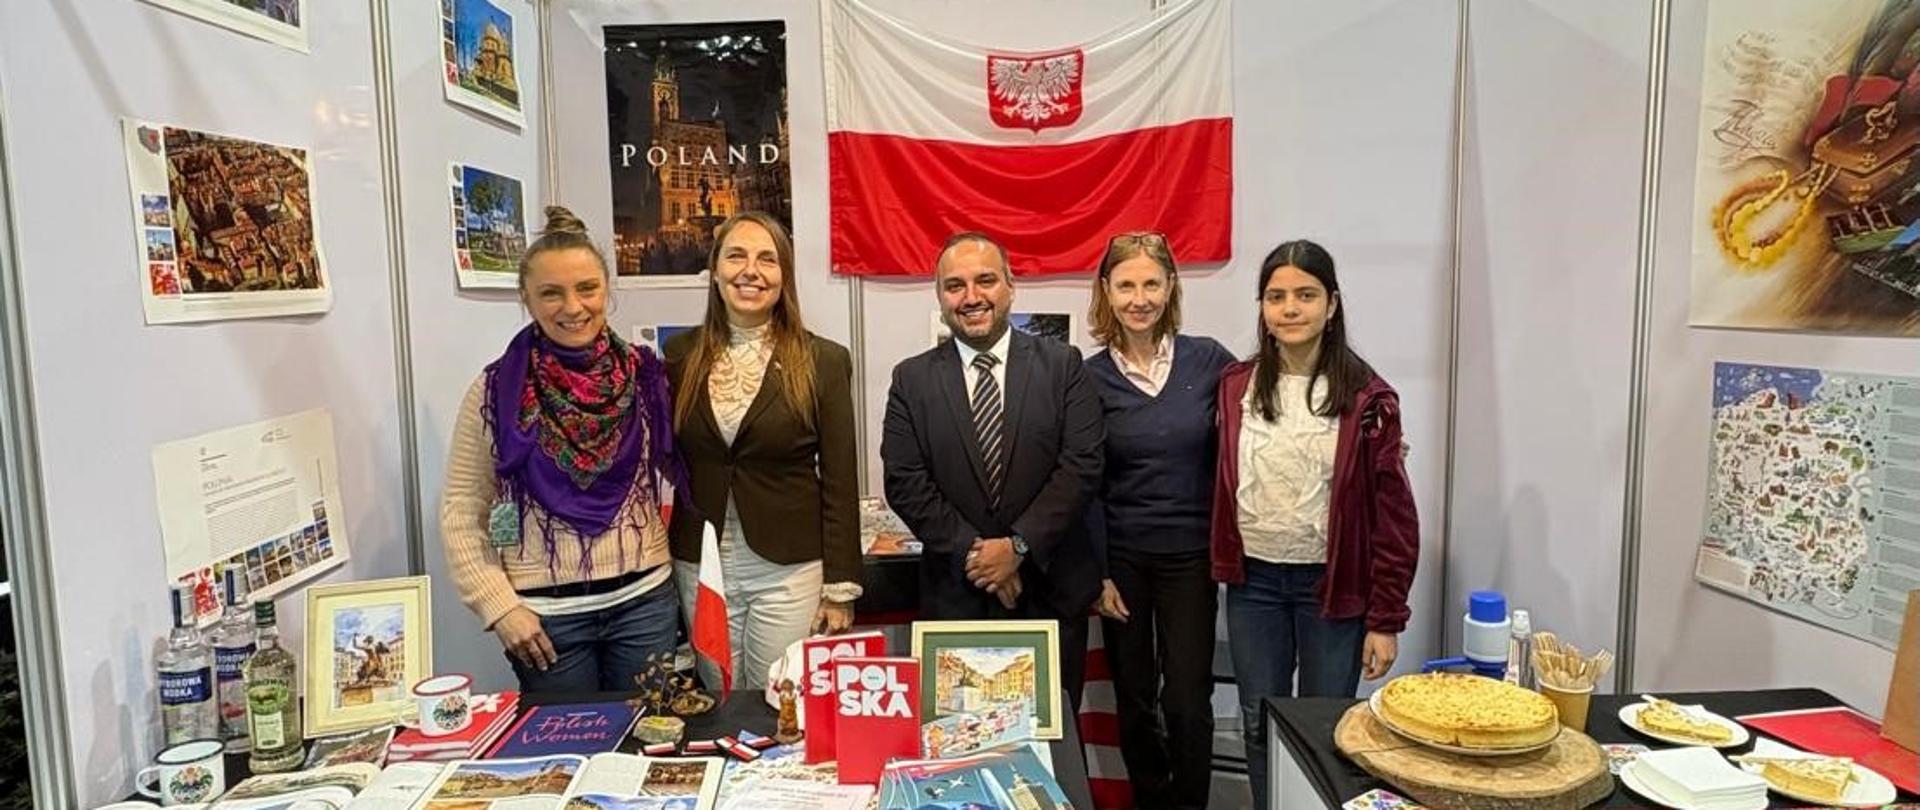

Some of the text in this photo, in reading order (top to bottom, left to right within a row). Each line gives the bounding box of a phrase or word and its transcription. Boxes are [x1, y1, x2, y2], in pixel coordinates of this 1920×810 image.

[620, 143, 779, 167] POLAND
[837, 664, 909, 693] POL
[839, 690, 913, 718] SKA
[535, 714, 609, 732] Polish
[521, 730, 611, 745] Women
